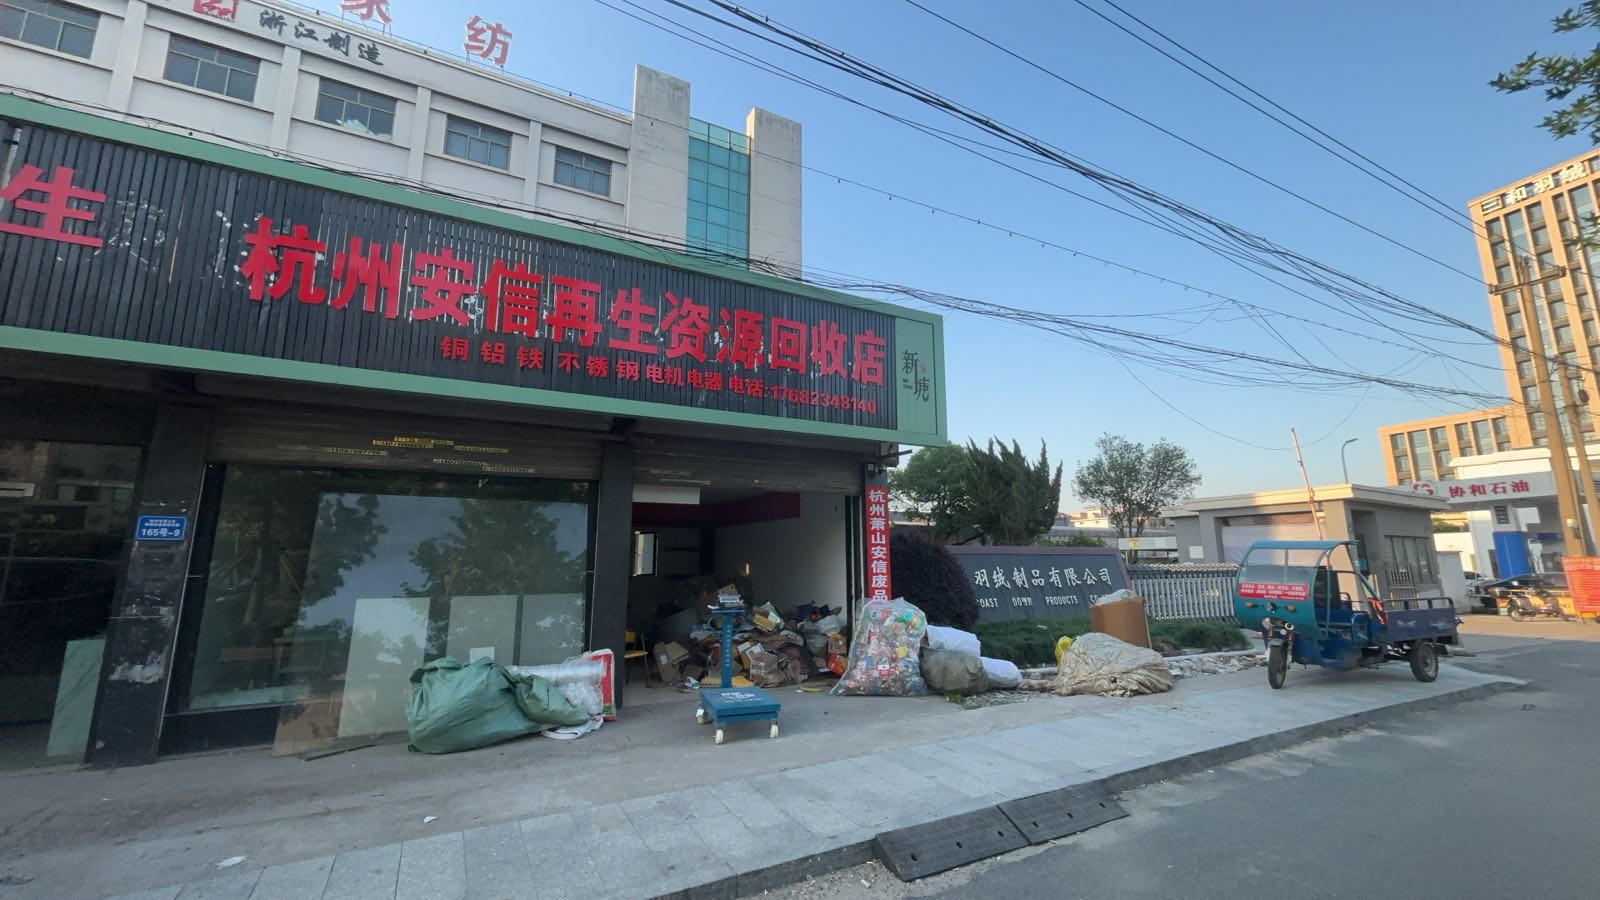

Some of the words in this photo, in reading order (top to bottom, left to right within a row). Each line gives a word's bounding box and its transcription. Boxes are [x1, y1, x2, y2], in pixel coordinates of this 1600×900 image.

[259, 10, 383, 66] 浙江制造
[0, 164, 106, 248] 生
[239, 216, 887, 386] 杭州安信再生资源回收店
[1448, 480, 1530, 498] 协和石油
[142, 528, 180, 537] 165号-9
[974, 566, 1112, 589] 羽绒制品有限公司
[976, 597, 999, 608] OAST
[1011, 597, 1032, 606] DOWN
[1045, 595, 1079, 606] PRODUCTS
